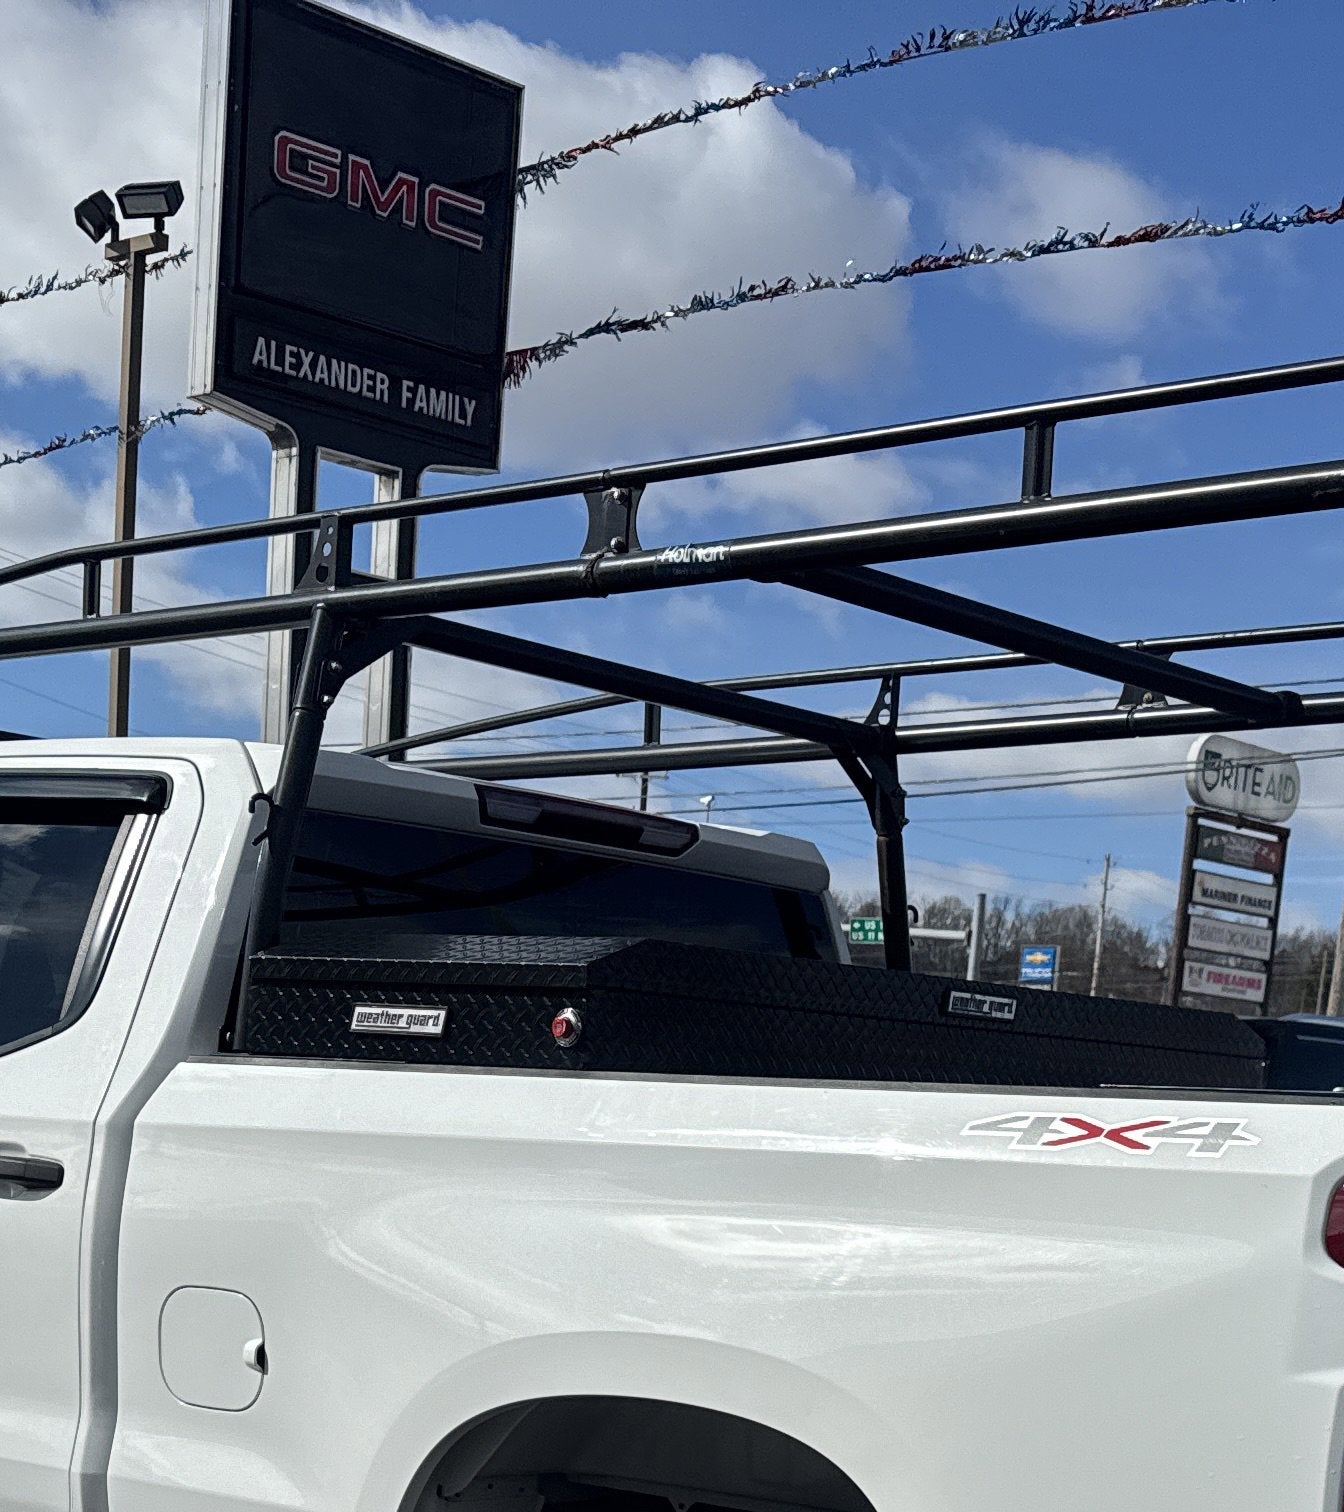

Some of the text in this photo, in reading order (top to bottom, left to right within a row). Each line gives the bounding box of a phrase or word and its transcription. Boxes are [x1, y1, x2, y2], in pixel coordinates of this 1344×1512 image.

[273, 130, 485, 251] GMC
[252, 336, 476, 427] ALEXANDER FAMILY
[1220, 759, 1296, 804] RITE AID
[852, 931, 864, 941] US
[864, 920, 876, 930] US
[356, 1009, 441, 1029] weather guard
